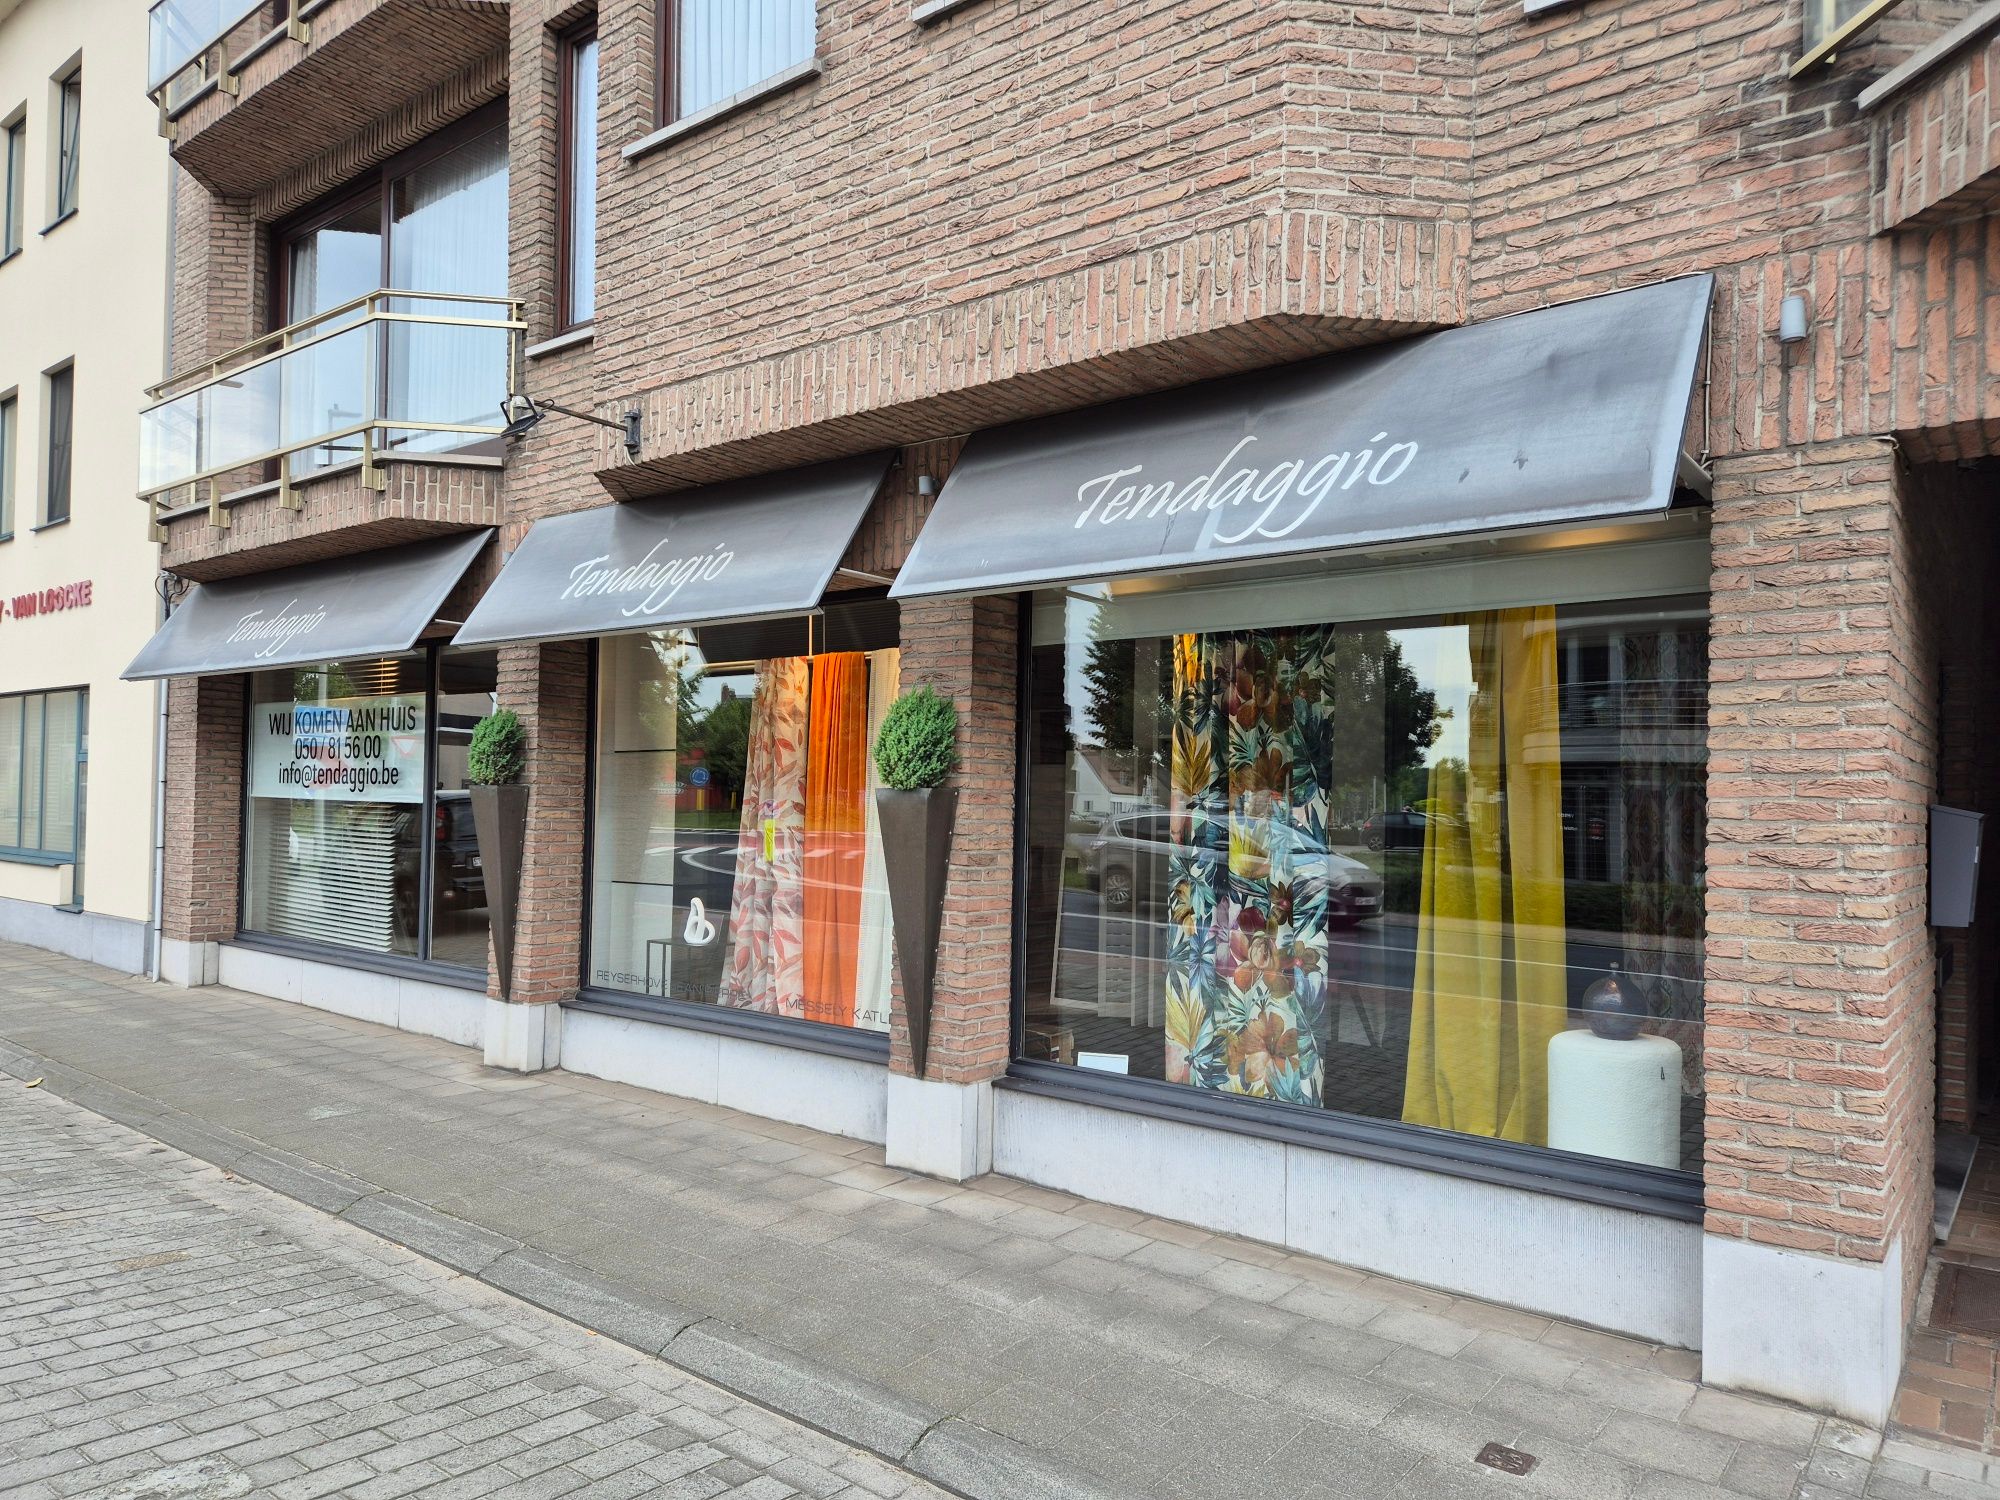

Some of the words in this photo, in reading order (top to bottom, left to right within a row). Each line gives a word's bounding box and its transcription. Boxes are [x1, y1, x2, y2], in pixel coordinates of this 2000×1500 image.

[1074, 431, 1419, 544] Tendaggio
[560, 537, 735, 617] Tendaggio
[12, 592, 37, 620] VAN
[39, 579, 93, 614] LOOCKE
[226, 598, 328, 659] Tendaggio
[269, 712, 292, 736] WIJ
[294, 709, 342, 734] KOMEN
[346, 708, 376, 733] AAN
[380, 705, 416, 731] HUIS
[295, 737, 317, 760] 050
[328, 736, 341, 760] 81
[344, 735, 361, 759] 56
[364, 735, 381, 759] 00
[278, 760, 400, 793] info@tendaggio.be
[785, 998, 848, 1017] MESSELY
[852, 1008, 888, 1025] KATL
